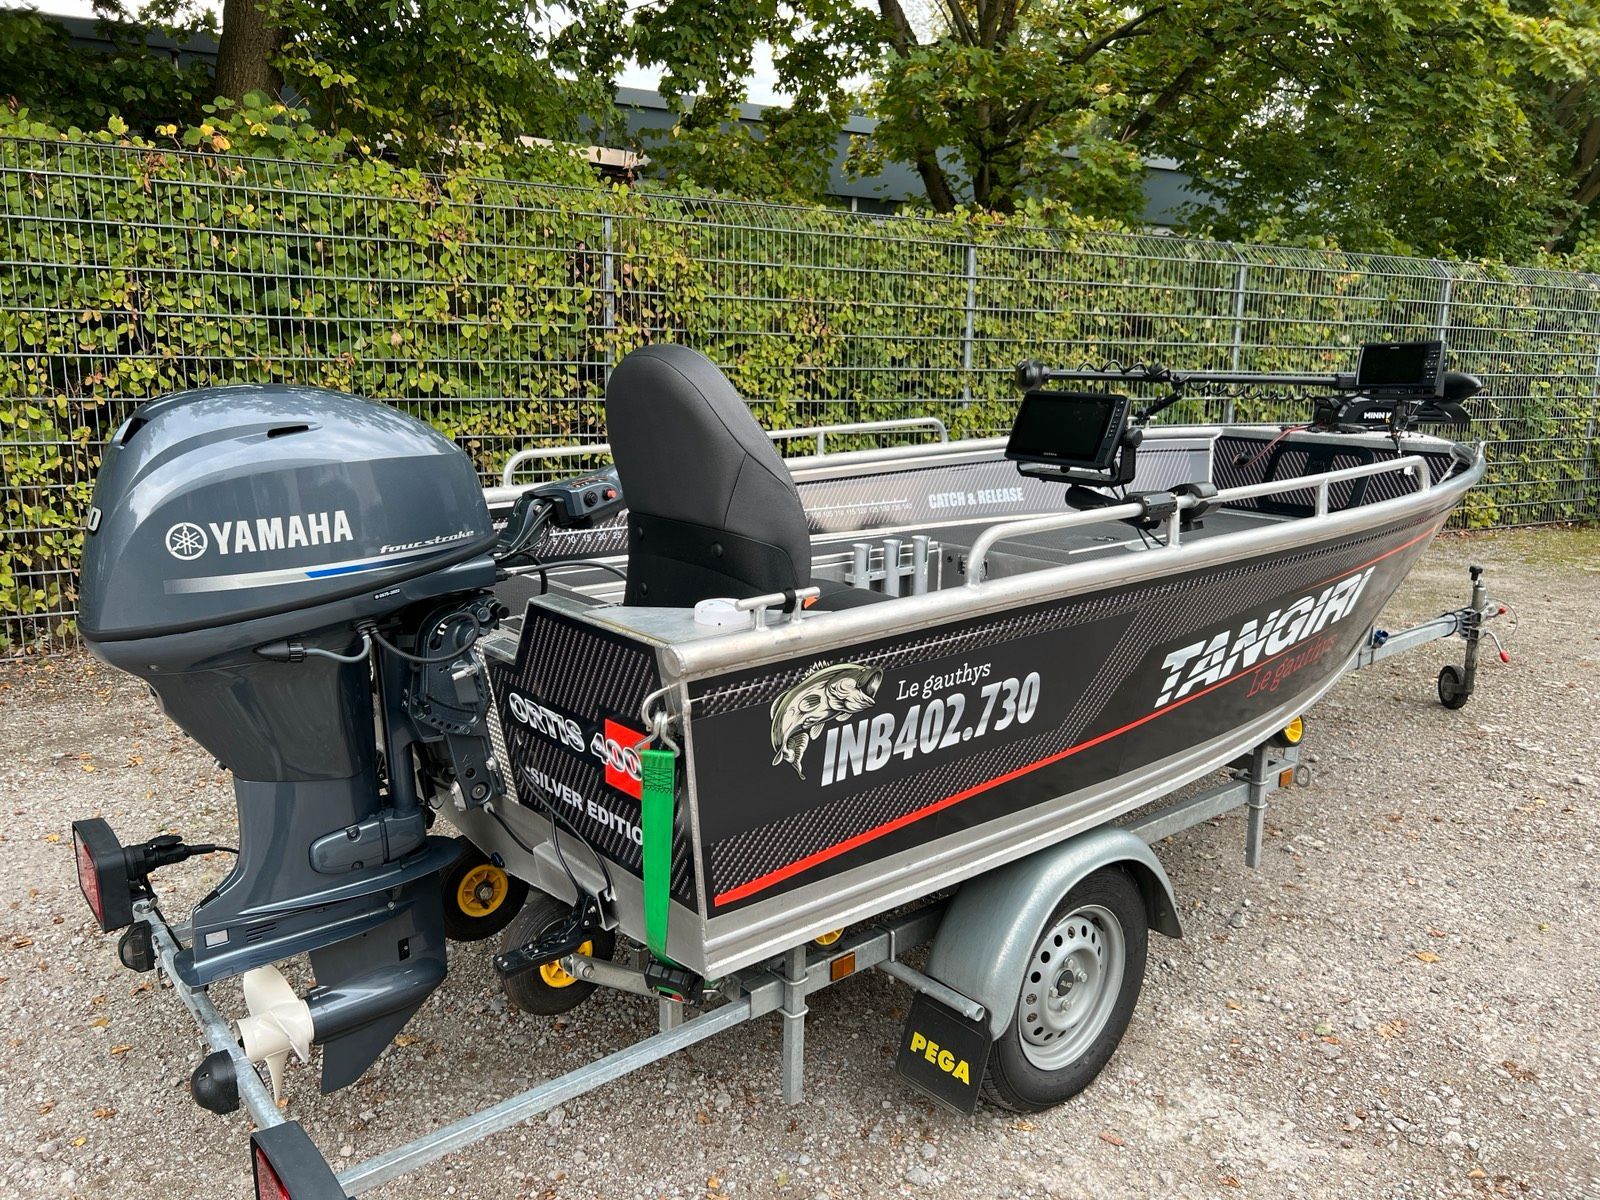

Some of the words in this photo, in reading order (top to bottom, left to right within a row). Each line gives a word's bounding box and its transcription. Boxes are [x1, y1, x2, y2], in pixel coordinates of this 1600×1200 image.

[1363, 411, 1386, 419] MINN
[928, 491, 966, 509] CATCH
[967, 492, 978, 506] &
[978, 486, 1025, 505] RELEASE
[208, 509, 354, 556] YAMAHA
[567, 535, 577, 544] 10
[598, 531, 607, 541] 20
[612, 530, 622, 539] 25
[1154, 566, 1377, 709] TANGIRI
[895, 680, 920, 701] Le
[922, 660, 992, 699] gauthys
[1246, 667, 1272, 699] Le
[508, 692, 585, 753] ORTIS
[590, 732, 643, 781] 400
[820, 671, 1041, 787] INB402.730
[587, 799, 643, 846] EDITIO
[909, 1031, 971, 1086] PEGA
